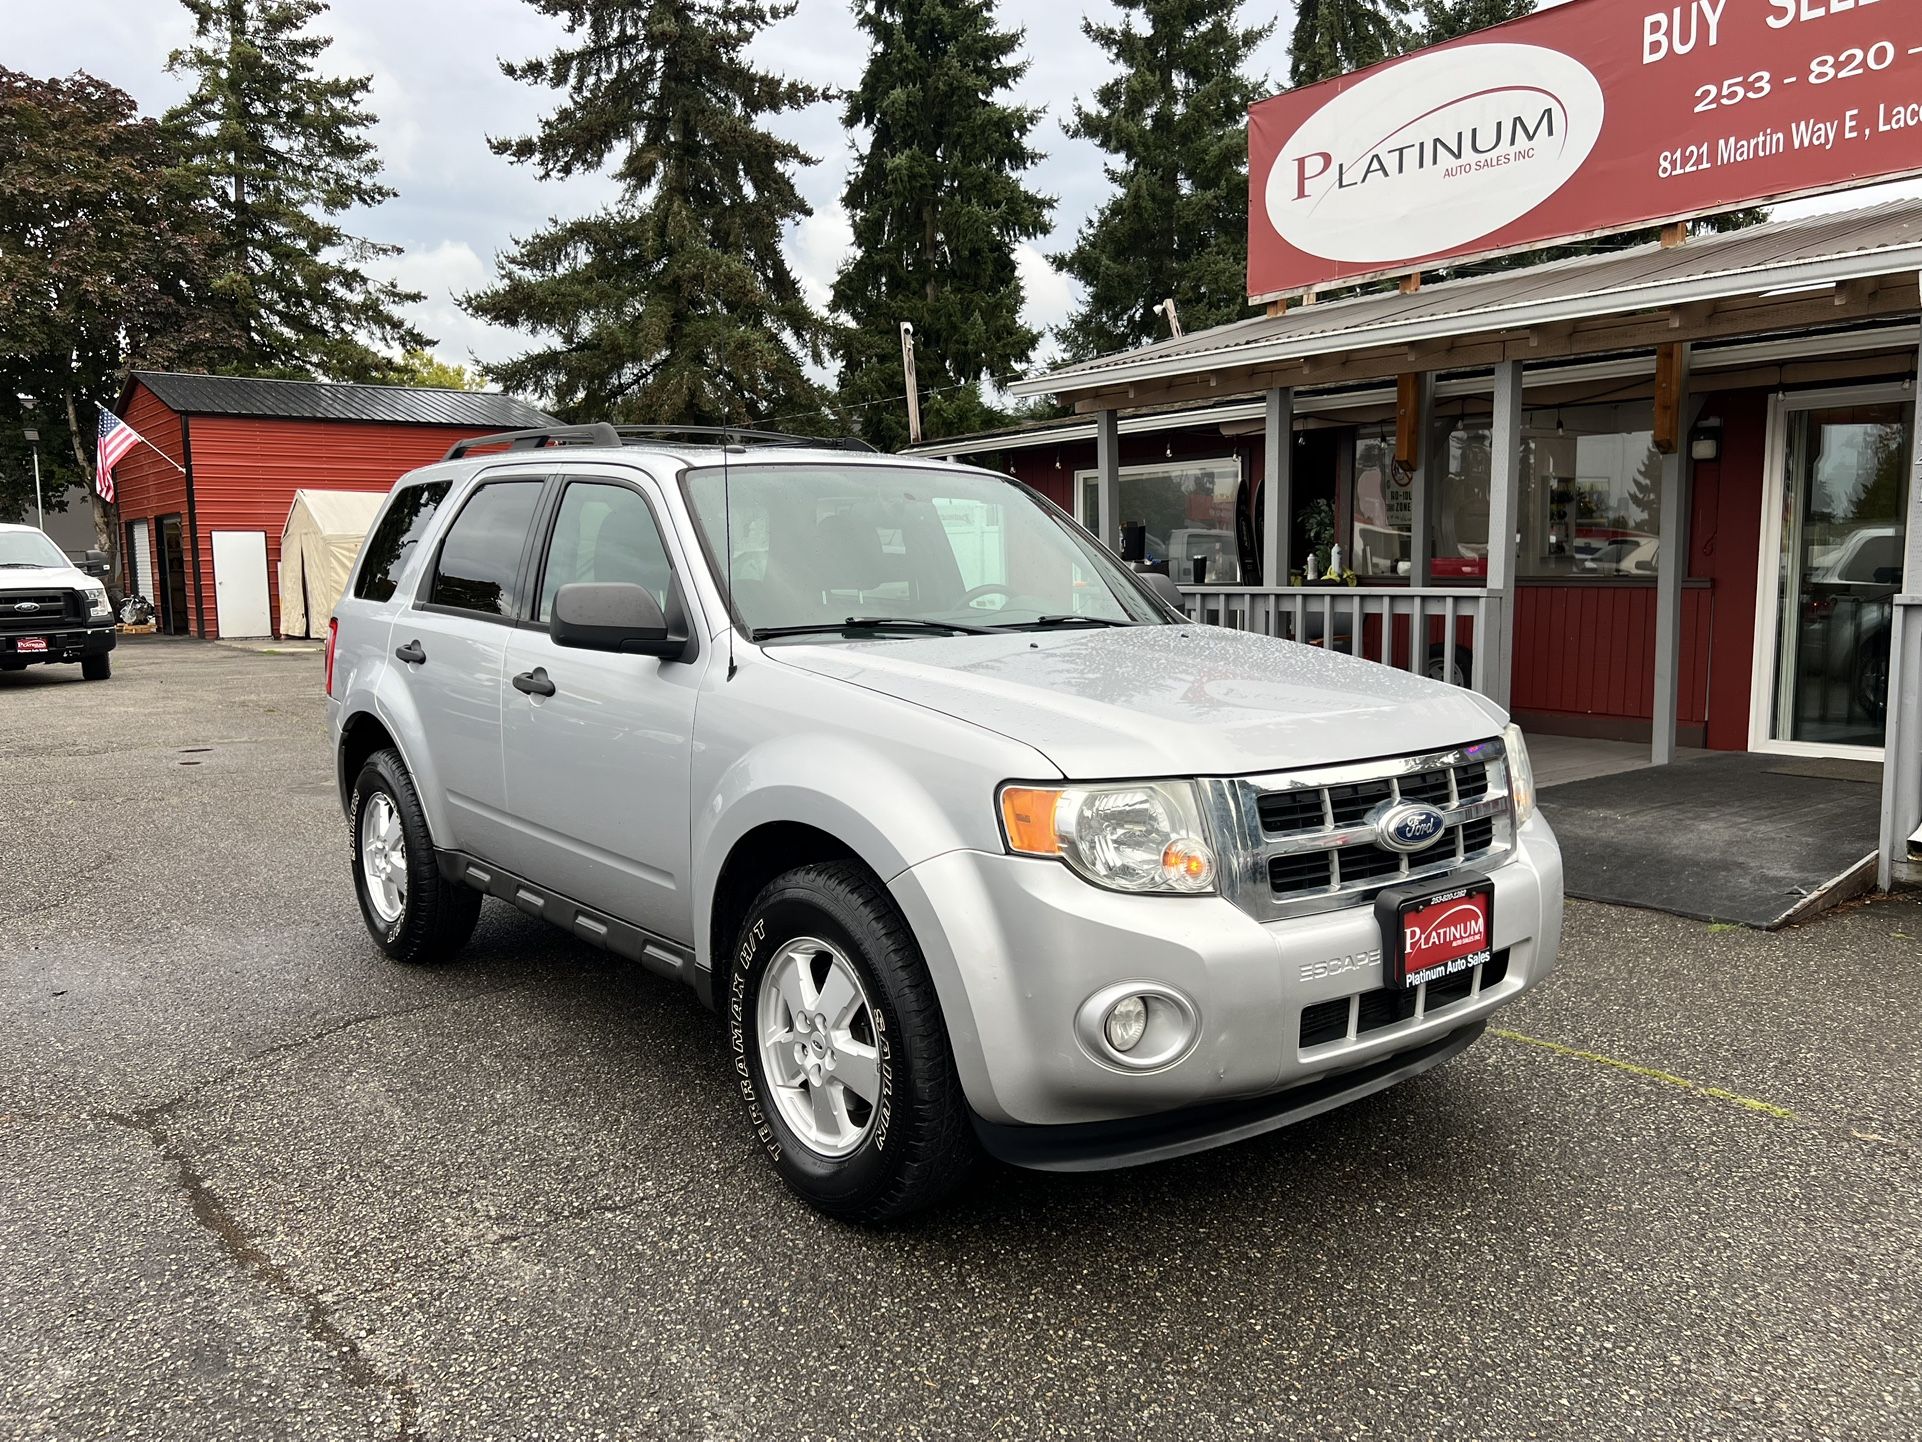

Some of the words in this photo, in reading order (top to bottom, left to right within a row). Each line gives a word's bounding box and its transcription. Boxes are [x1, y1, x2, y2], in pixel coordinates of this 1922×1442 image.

[1642, 0, 1727, 65] BUY
[1693, 71, 1771, 113] 253
[1808, 41, 1895, 84] 820
[1290, 107, 1555, 202] PLATINUM
[1443, 162, 1472, 180] AUTO
[1474, 152, 1511, 172] SALES
[1513, 147, 1535, 162] INC
[1658, 142, 1712, 178] 8121
[1717, 128, 1784, 166] Martin
[1791, 119, 1838, 149] Way
[1405, 814, 1434, 838] Ford
[1299, 948, 1381, 982] ESCAPE
[1404, 917, 1484, 954] PLATINUM
[1405, 966, 1446, 988] Platinum
[1446, 959, 1467, 975] Auto
[1467, 950, 1491, 967] Sales
[731, 972, 782, 1161] TERRAMAX
[873, 1008, 892, 1151] SAILUN
